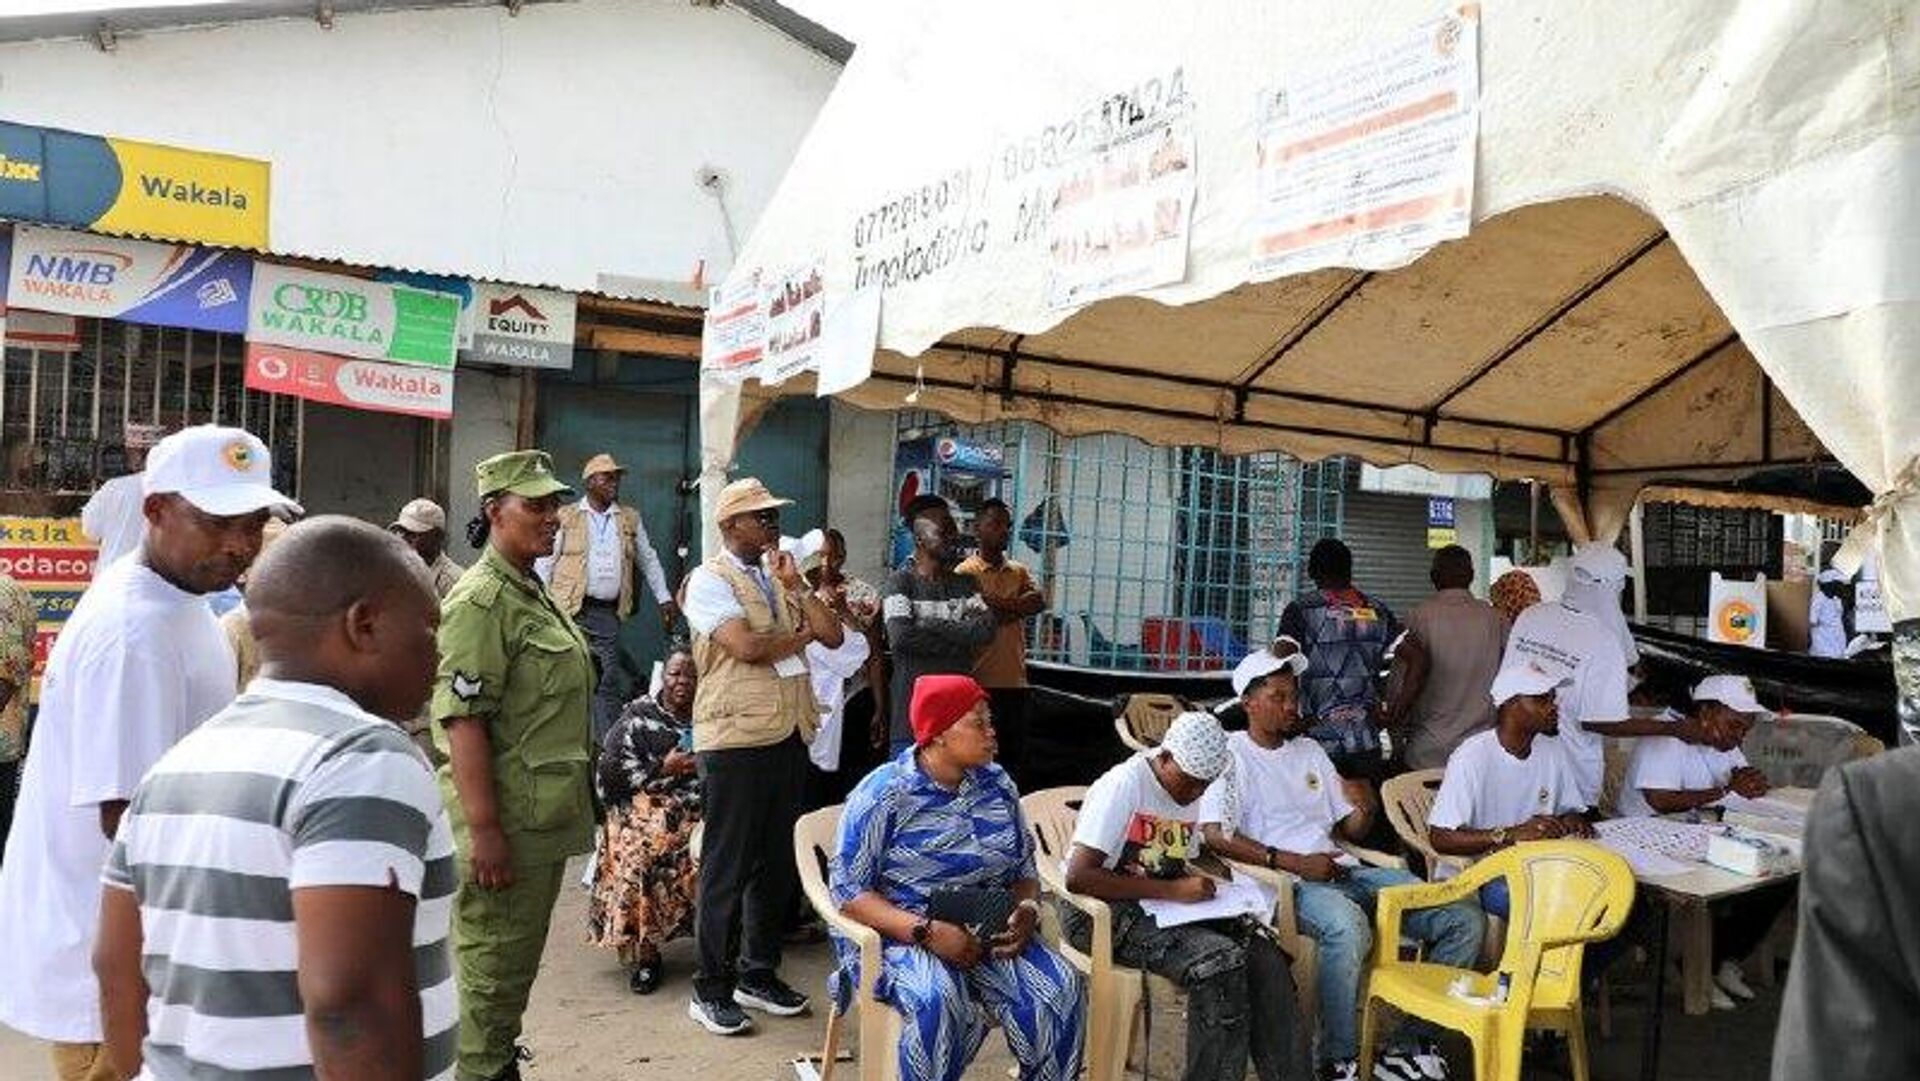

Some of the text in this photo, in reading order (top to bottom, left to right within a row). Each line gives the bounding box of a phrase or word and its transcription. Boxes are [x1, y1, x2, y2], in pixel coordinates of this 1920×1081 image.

[141, 174, 248, 210] Wakala
[26, 254, 117, 286] NMB
[23, 279, 115, 304] WAKALA
[262, 310, 384, 345] WAKALA
[488, 317, 550, 335] EQUITY
[482, 340, 551, 361] WAKALA
[353, 367, 442, 396] Wakala
